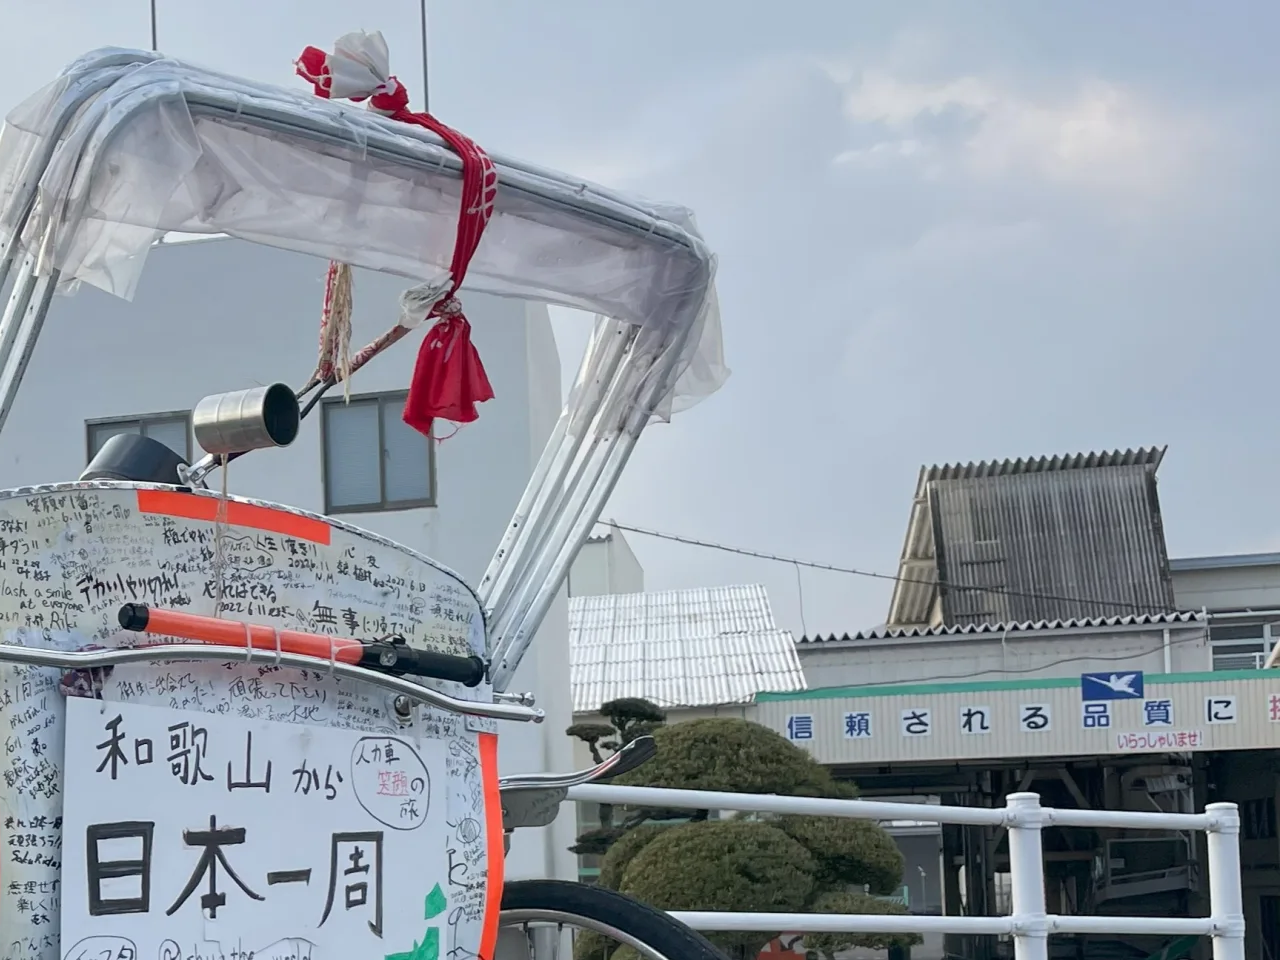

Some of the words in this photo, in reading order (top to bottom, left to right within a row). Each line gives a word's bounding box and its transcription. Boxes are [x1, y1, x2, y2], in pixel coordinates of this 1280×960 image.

[34, 589, 42, 598] a
[46, 582, 73, 600] smile
[20, 600, 36, 610] at
[42, 600, 85, 616] everyone
[1117, 731, 1203, 749] いらっしゃいませ!
[96, 713, 344, 800] 和歌山から
[355, 741, 401, 765] 人力車
[376, 770, 425, 796] 笑顔の
[400, 799, 420, 821] 旅
[87, 814, 384, 938] 日本一周
